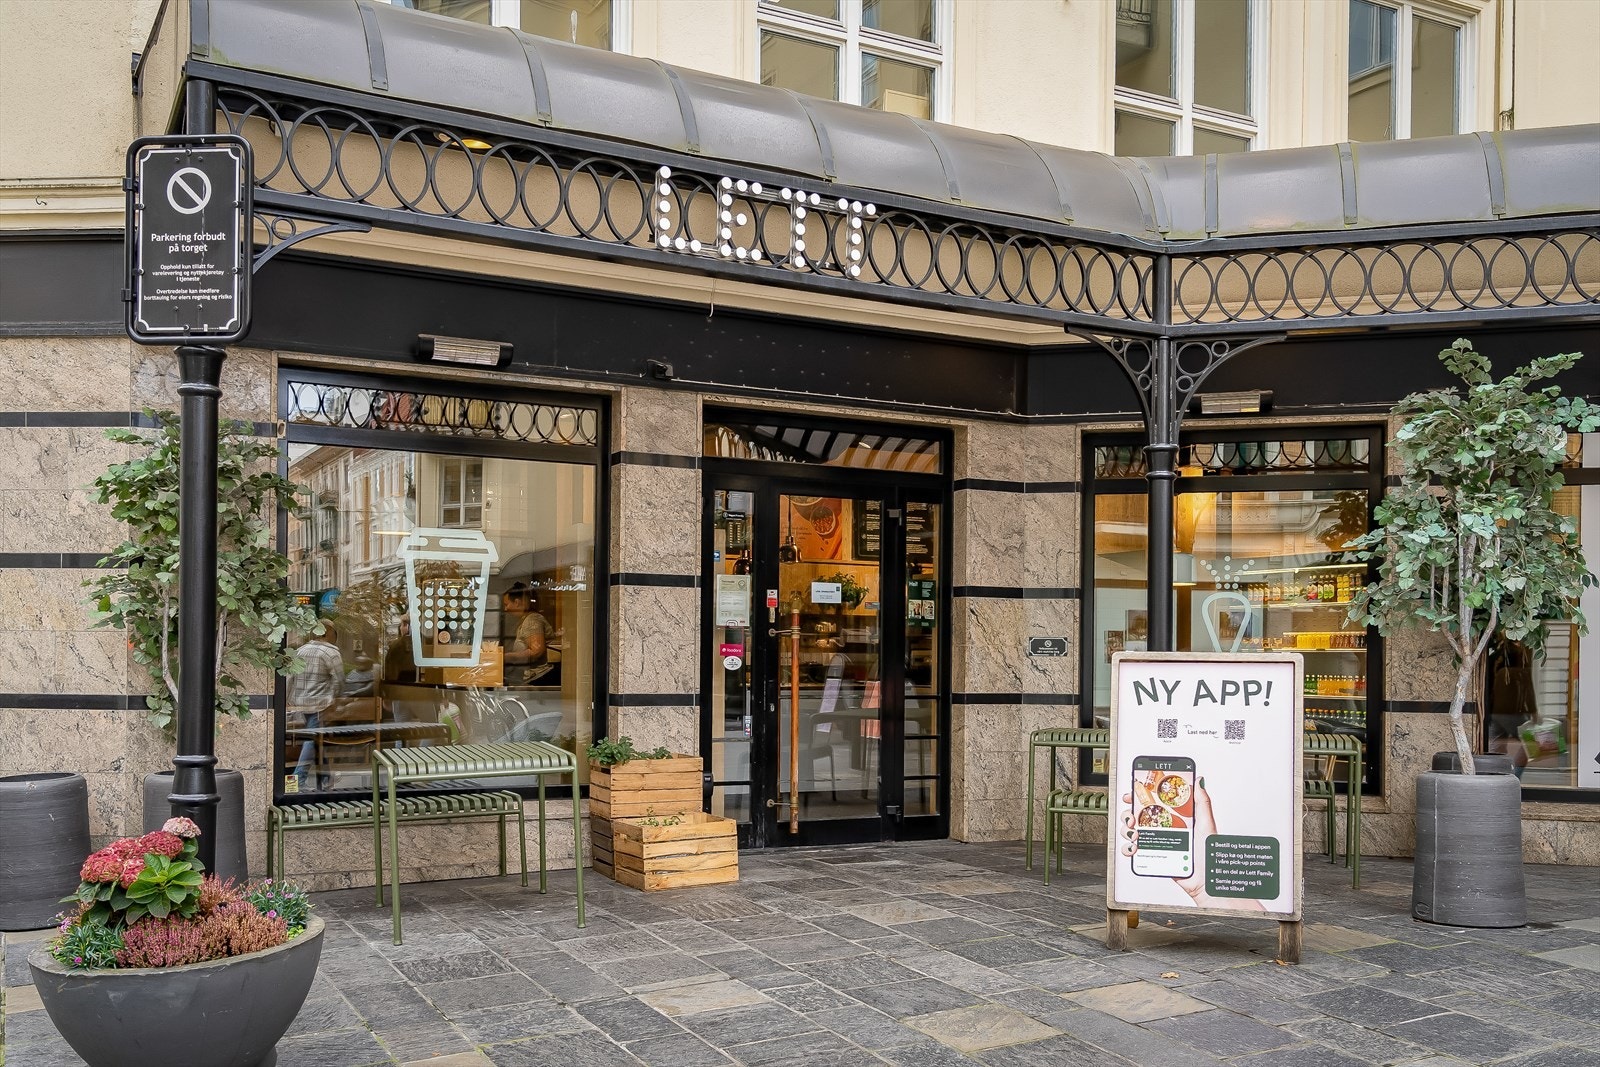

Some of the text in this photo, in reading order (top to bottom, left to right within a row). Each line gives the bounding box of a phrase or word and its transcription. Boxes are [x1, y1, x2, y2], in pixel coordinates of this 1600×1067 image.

[655, 165, 876, 279] LETT
[151, 232, 226, 242] Parkering forbudt
[168, 243, 208, 254] på torget
[1133, 677, 1273, 706] NY APP!
